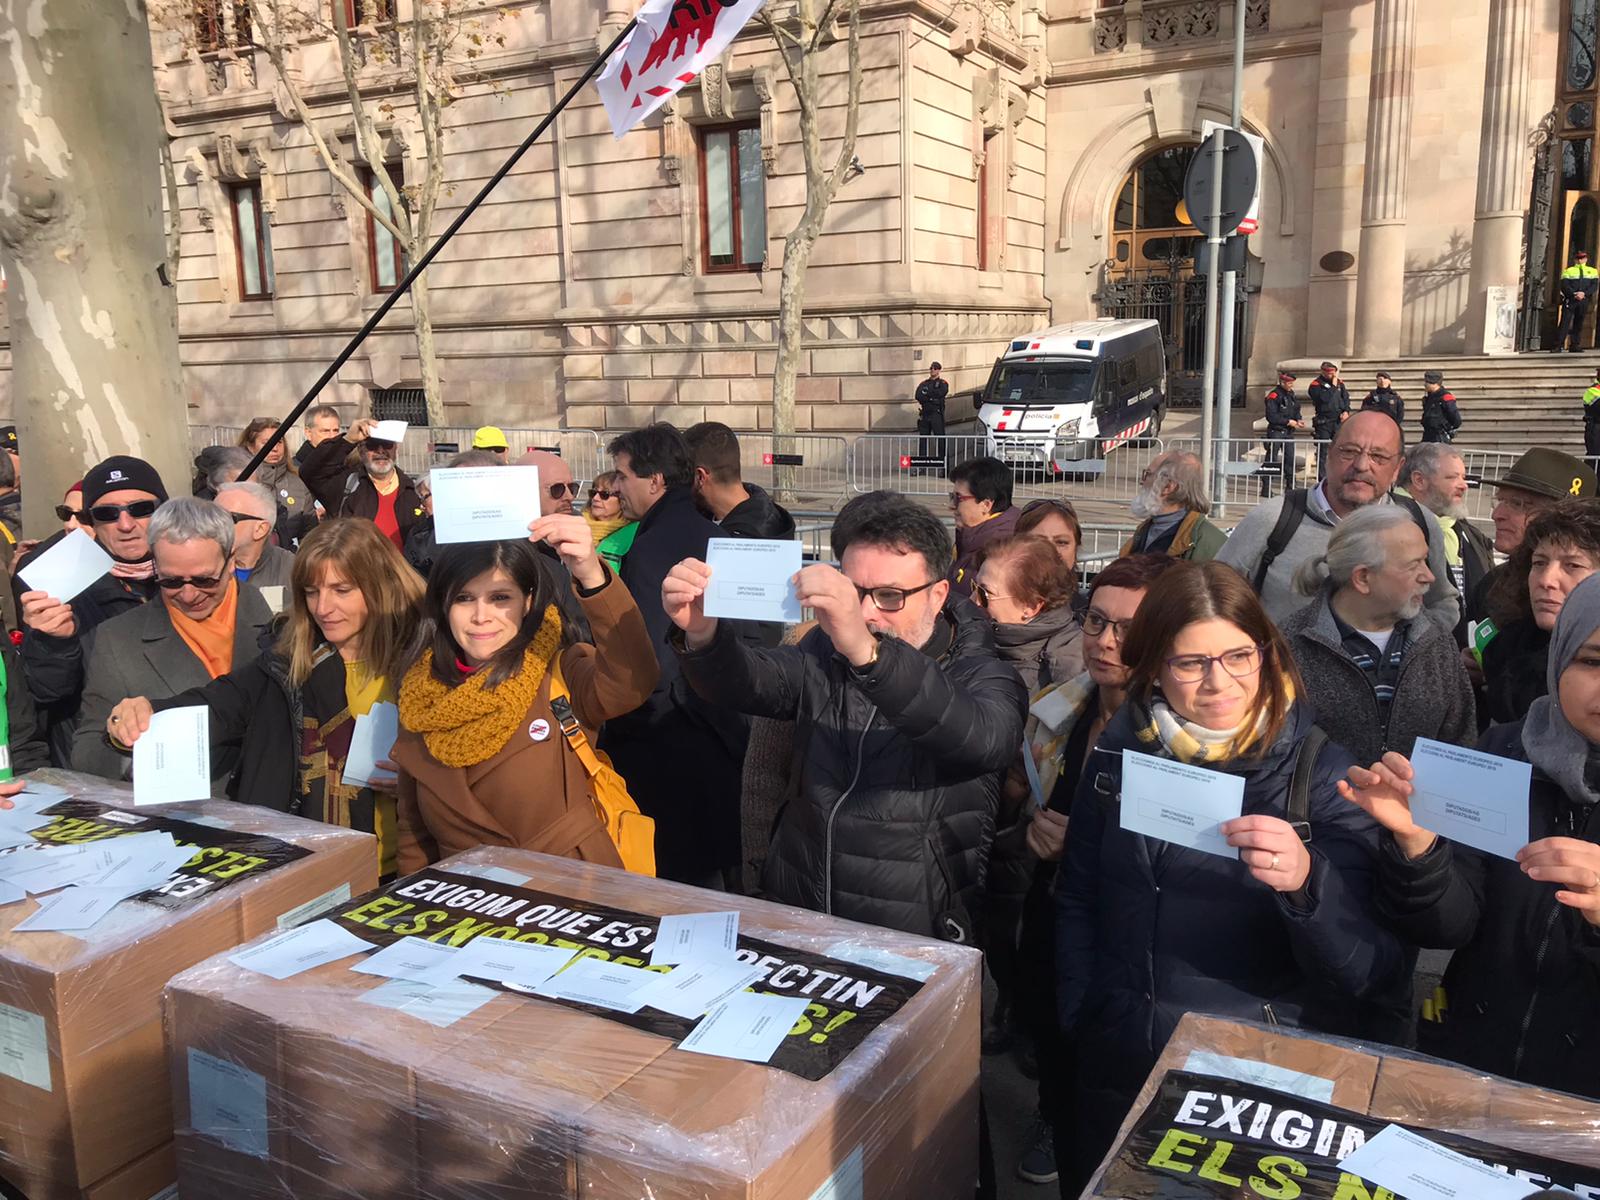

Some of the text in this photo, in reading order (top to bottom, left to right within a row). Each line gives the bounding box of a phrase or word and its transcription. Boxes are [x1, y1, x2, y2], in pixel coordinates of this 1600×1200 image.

[342, 896, 449, 936] ELS
[396, 878, 529, 918] EXIGIM
[515, 903, 603, 936] QUE
[587, 919, 652, 948] ES
[1147, 1128, 1307, 1200] ELS
